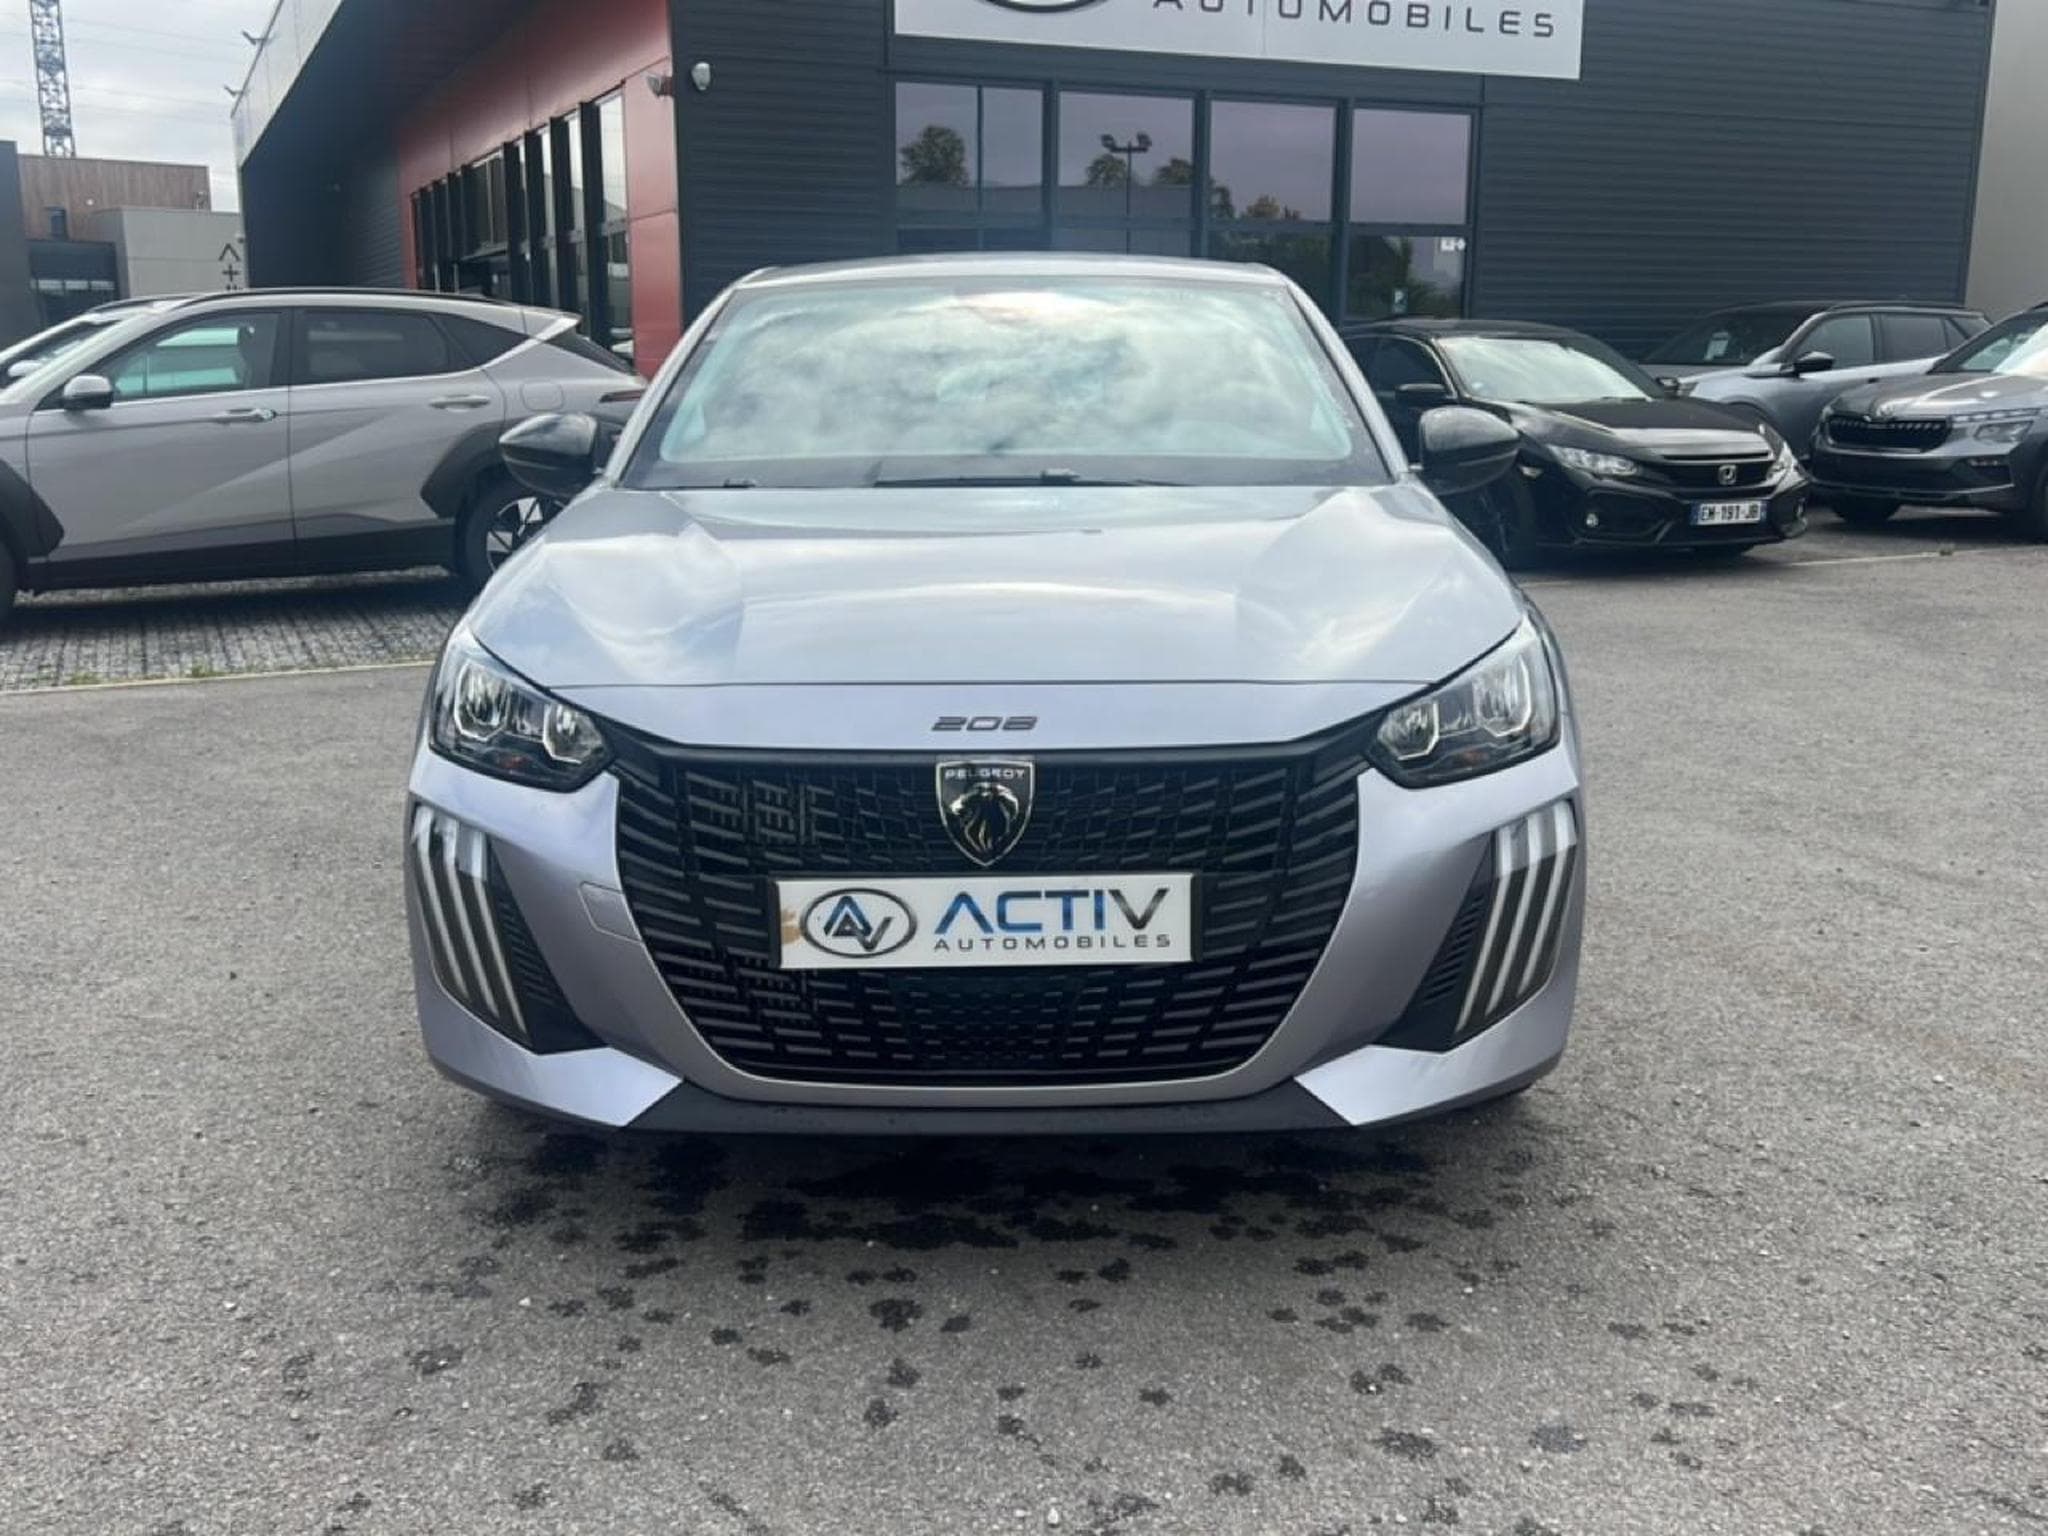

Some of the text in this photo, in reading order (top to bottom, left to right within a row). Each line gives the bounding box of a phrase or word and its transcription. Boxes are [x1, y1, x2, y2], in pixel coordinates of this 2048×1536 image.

[931, 716, 1037, 731] 208
[935, 888, 1169, 935] ACTIV
[935, 934, 1171, 951] AUTOMOBILES
